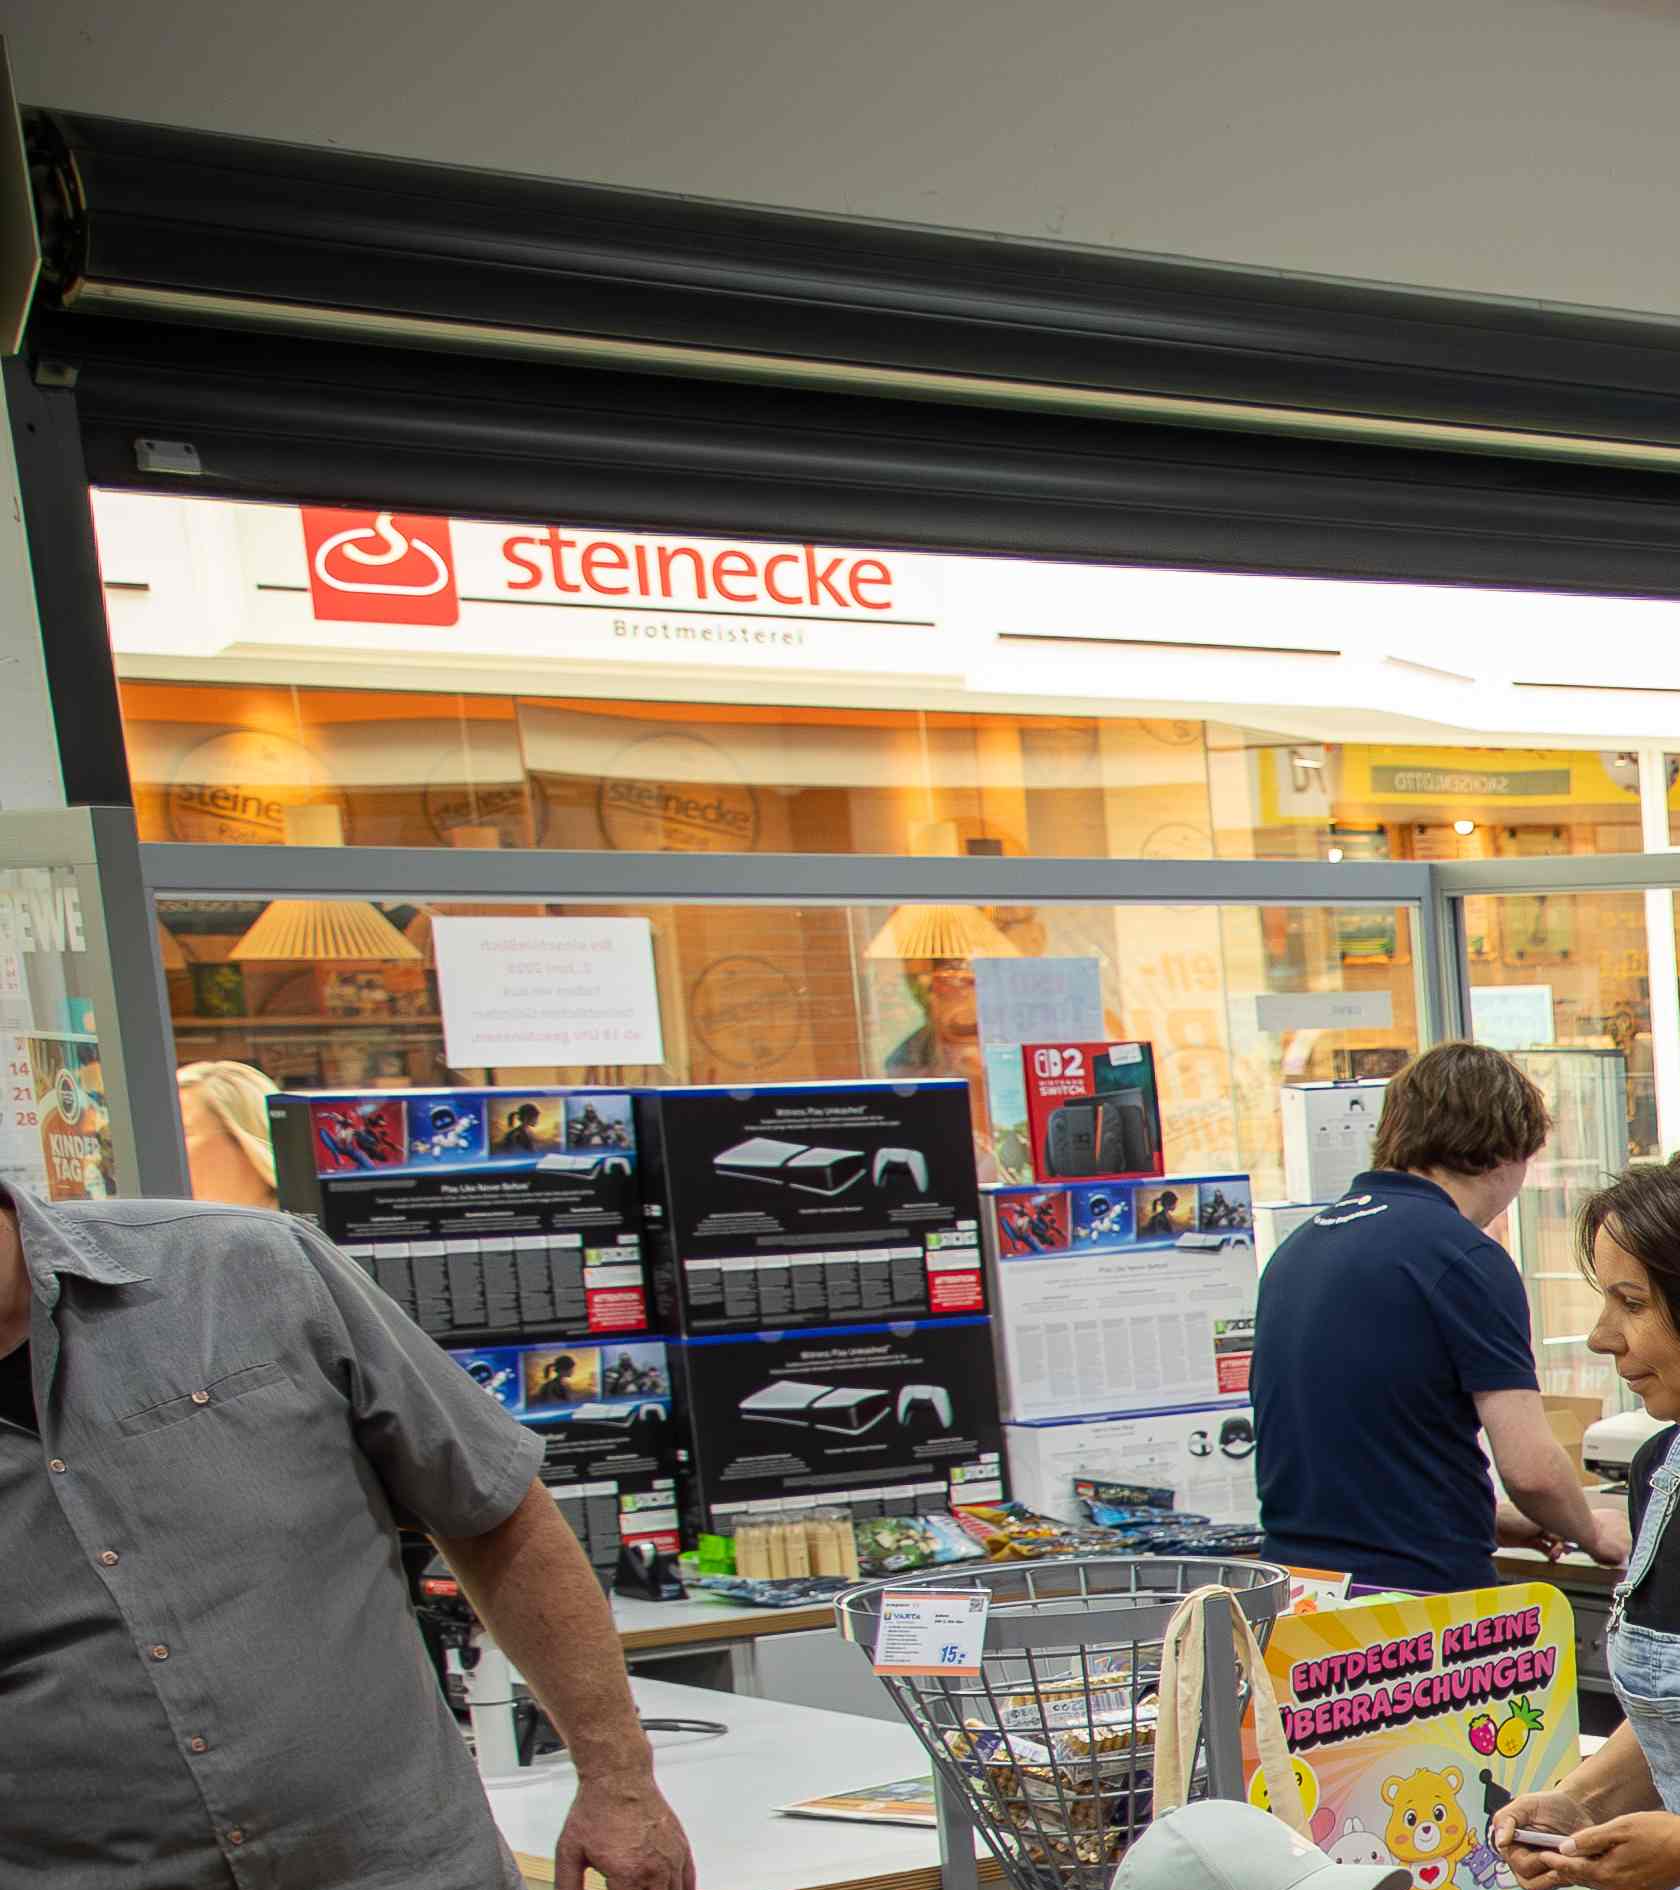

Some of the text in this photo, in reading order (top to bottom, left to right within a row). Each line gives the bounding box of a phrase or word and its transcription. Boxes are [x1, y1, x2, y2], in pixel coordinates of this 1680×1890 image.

[501, 525, 894, 610] steinecke
[612, 619, 806, 647] Brotmeisterei
[1062, 1048, 1086, 1077] 2
[54, 1157, 82, 1181] TAG
[1292, 1606, 1541, 1695] ENTDECKE KLEINE
[1280, 1648, 1557, 1750] ÜBERRASCHUNGEN
